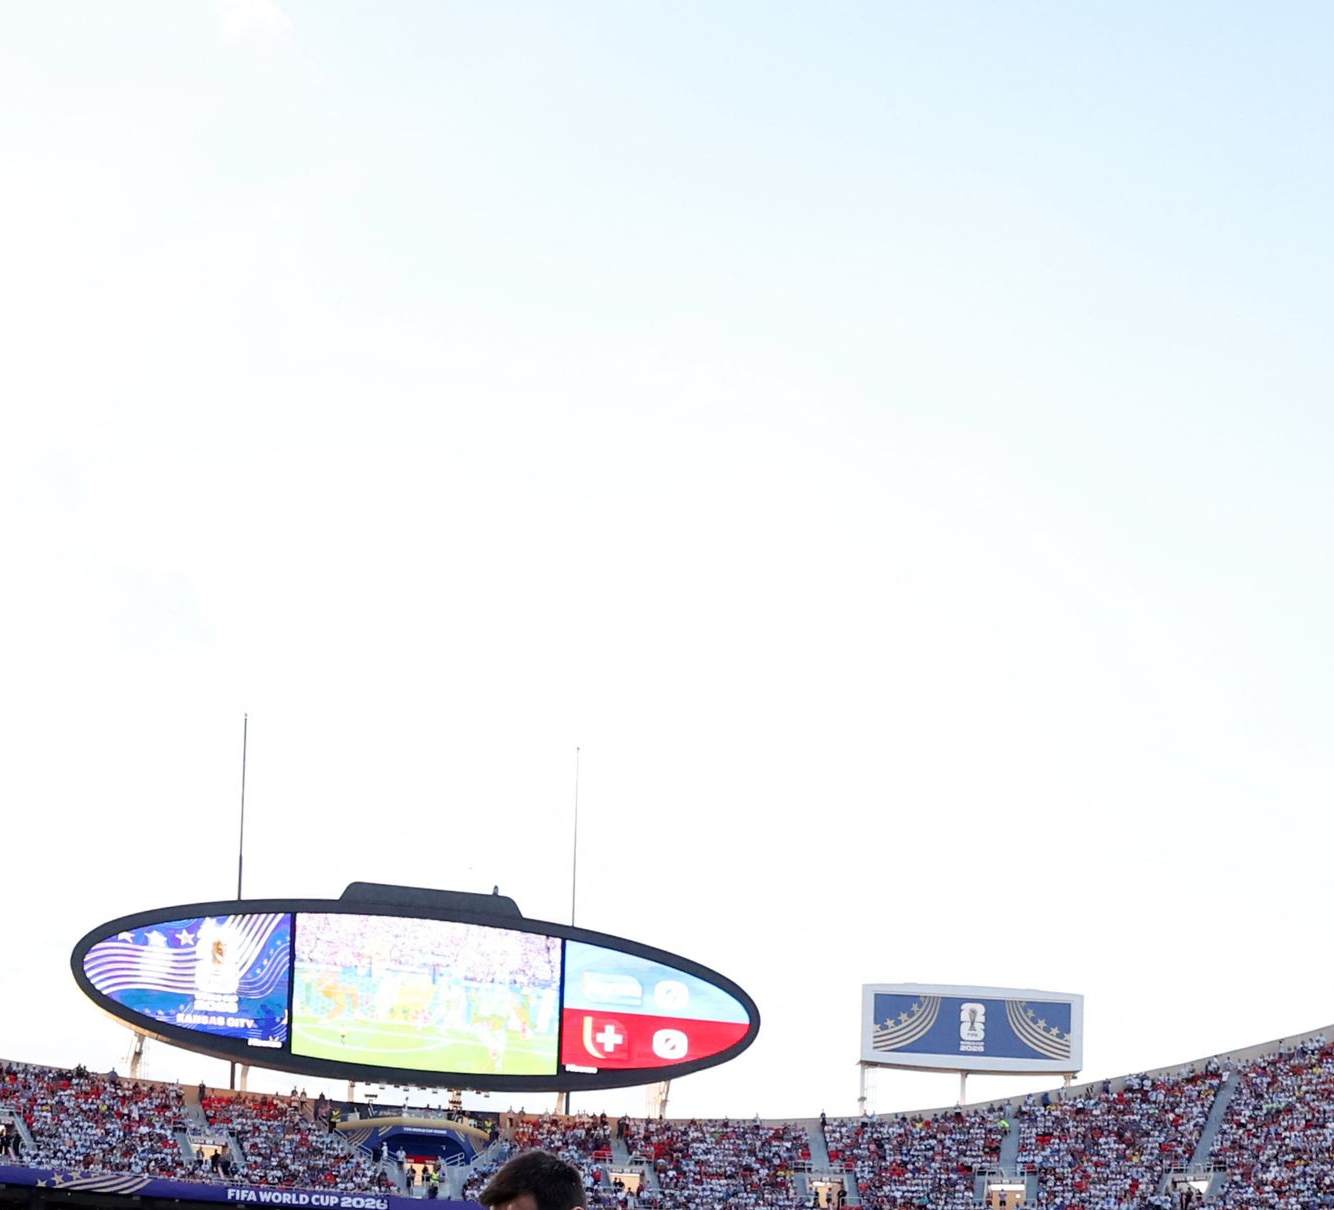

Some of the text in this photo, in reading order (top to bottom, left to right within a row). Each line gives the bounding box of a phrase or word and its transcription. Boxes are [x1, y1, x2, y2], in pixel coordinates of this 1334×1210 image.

[176, 1013, 225, 1026] KANSAS
[227, 1189, 388, 1210] FIFA WORLD CUP 2026
